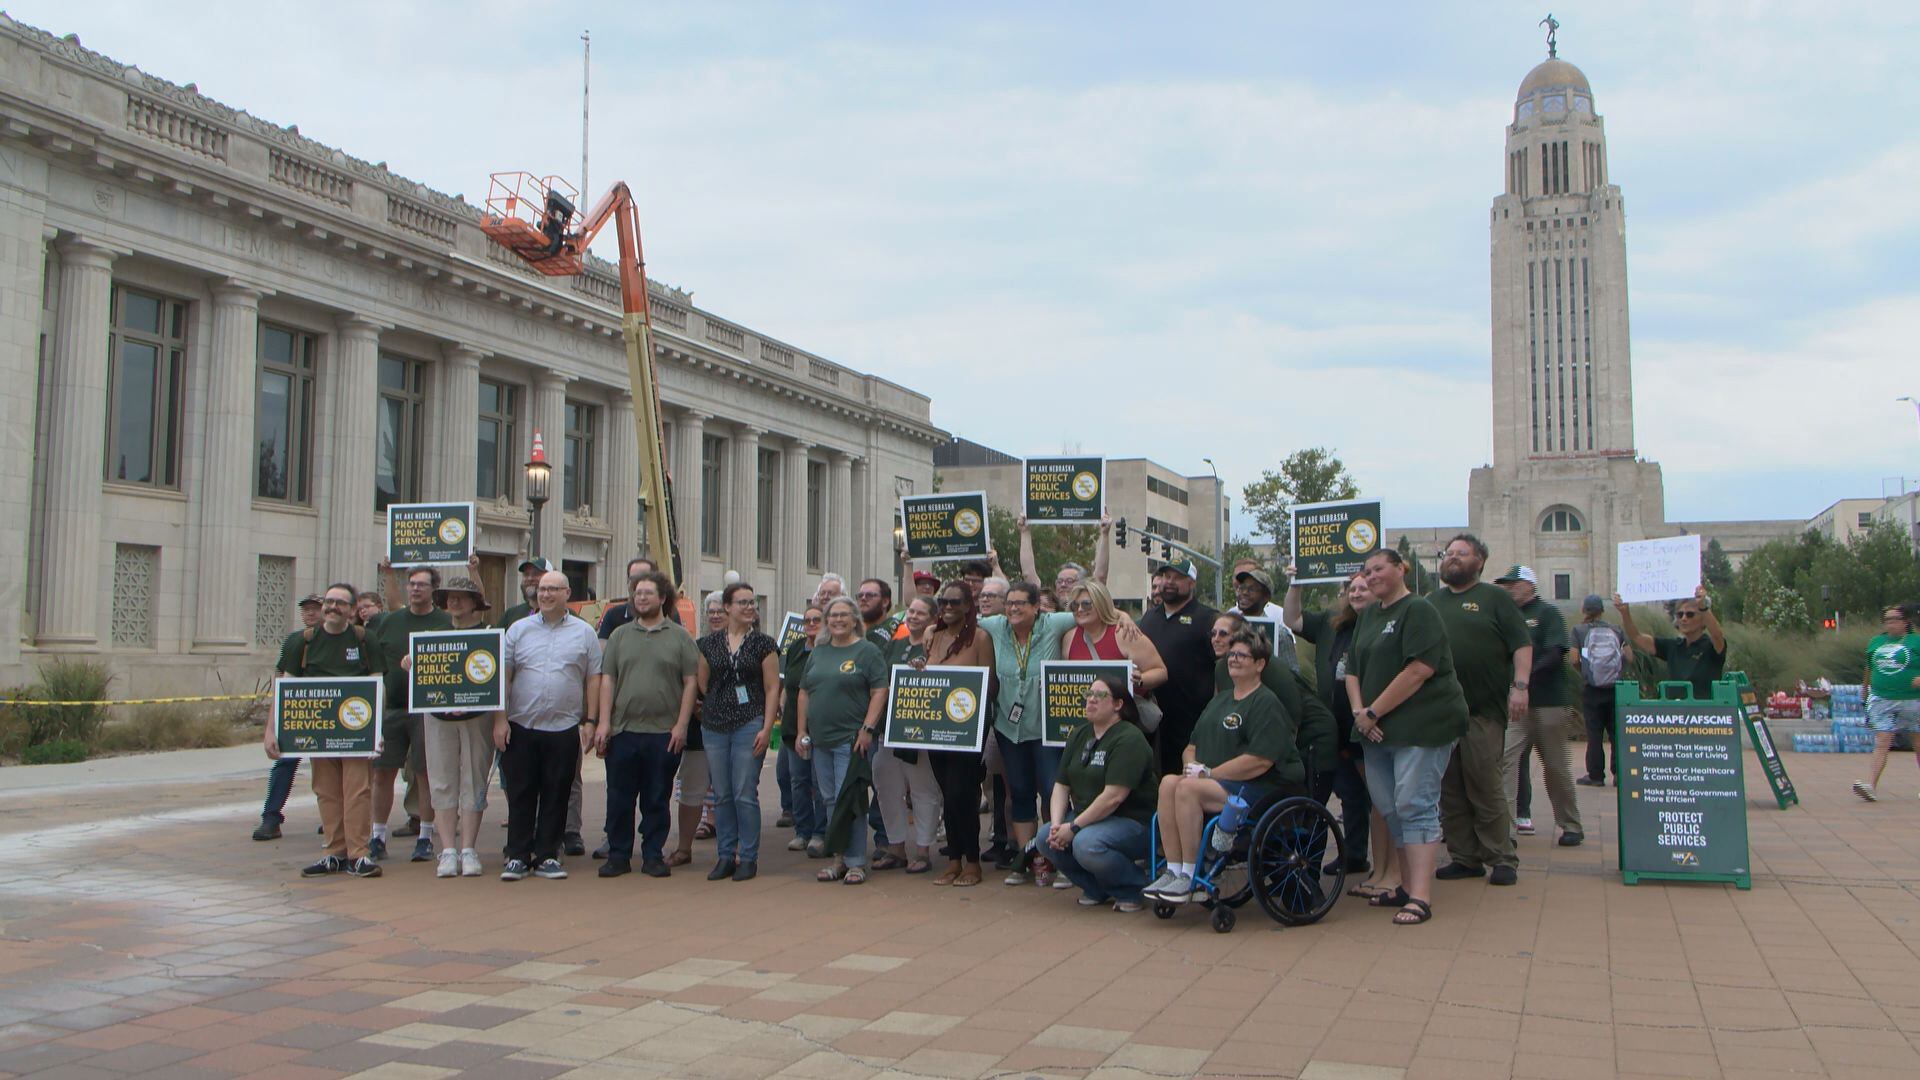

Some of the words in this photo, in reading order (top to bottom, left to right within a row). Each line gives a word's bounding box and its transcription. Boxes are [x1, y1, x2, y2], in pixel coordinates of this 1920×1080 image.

[1030, 465, 1037, 473] WE
[1039, 465, 1048, 473] ARE
[1049, 464, 1075, 472] NEBRASKA
[1030, 473, 1068, 482] PROTECT
[1030, 482, 1059, 491] PUBLIC
[1030, 491, 1070, 500] SERVICES
[917, 504, 927, 512] ARE
[928, 503, 955, 511] NEBRASKA
[404, 512, 414, 520] ARE
[415, 511, 441, 519] NEBRASKA
[909, 511, 949, 522] PROTECT
[1299, 517, 1306, 525] WE
[1308, 515, 1318, 524] ARE
[1319, 512, 1348, 522] NEBRASKA
[395, 520, 435, 529] PROTECT
[909, 521, 940, 531] PUBLIC
[1299, 523, 1341, 536] PROTECT
[395, 529, 426, 537] PUBLIC
[910, 528, 953, 539] SERVICES
[394, 537, 437, 546] SERVICES
[1299, 535, 1331, 546] PUBLIC
[1299, 544, 1344, 557] SERVICES
[417, 643, 425, 652] WE
[427, 643, 437, 652] ARE
[439, 642, 468, 651] NEBRASKA
[417, 652, 460, 664] PROTECT
[417, 664, 450, 674] PUBLIC
[417, 674, 463, 685] SERVICES
[899, 676, 907, 686] WE
[909, 677, 919, 686] ARE
[921, 678, 950, 687] NEBRASKA
[1049, 673, 1056, 682] WE
[1058, 673, 1068, 682] ARE
[284, 690, 293, 698] WE
[295, 689, 307, 698] ARE
[309, 688, 341, 698] NEBRASKA
[898, 687, 942, 698] PROTECT
[284, 699, 333, 709] PROTECT
[897, 698, 930, 709] PUBLIC
[1049, 695, 1081, 706] PUBLIC
[284, 710, 322, 720] PUBLIC
[896, 709, 942, 720] SERVICES
[1625, 714, 1654, 724] 2026
[1656, 714, 1733, 725] NAPE/AFSCME
[283, 720, 336, 730] SERVICES
[1626, 727, 1687, 735] NEGOTIATIONS
[1688, 727, 1734, 735] PRIORITIES
[1674, 743, 1692, 751] That
[1694, 744, 1713, 752] Keep
[1715, 744, 1726, 752] Up
[1705, 752, 1728, 760] Living
[1674, 766, 1688, 774] Our
[1691, 767, 1735, 775] Healthcare
[1666, 788, 1688, 796] State
[1689, 789, 1737, 797] Government
[1658, 811, 1703, 823] PROTECT
[1663, 823, 1700, 835] PUBLIC
[1658, 834, 1707, 846] SERVICES
